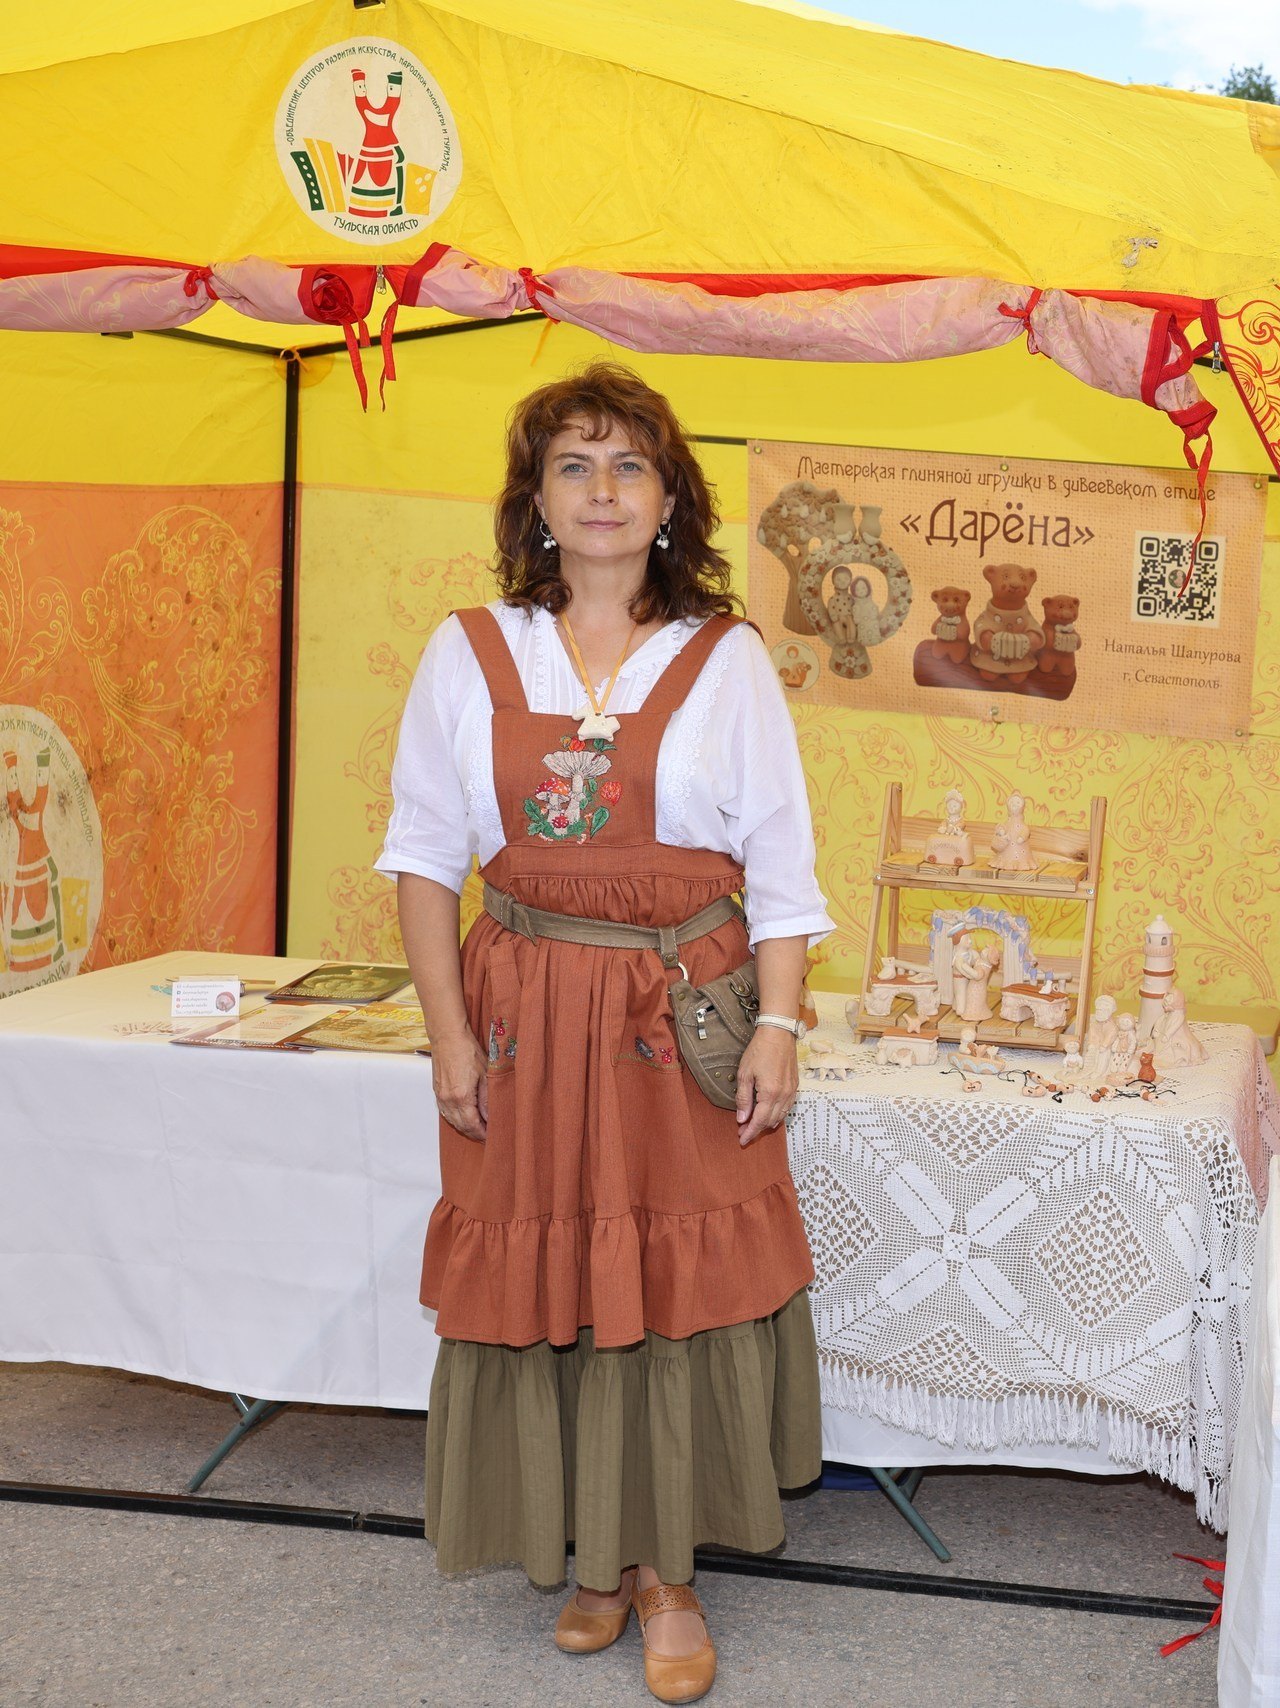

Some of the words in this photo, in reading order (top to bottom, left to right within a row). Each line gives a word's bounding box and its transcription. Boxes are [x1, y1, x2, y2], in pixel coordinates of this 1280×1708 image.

[298, 61, 325, 89] ЦЕНТРОВ
[325, 47, 356, 66] РАЗВИТИЯ
[426, 88, 446, 126] КУЛЬТУРЫ
[333, 216, 380, 236] ТУЛЬСКАЯ
[382, 219, 419, 235] ОБЛАСТЬ
[797, 456, 896, 483] Мастерская
[901, 468, 972, 485] глиняной
[977, 473, 1042, 493] игрушки
[899, 498, 1096, 559] «Дарёна»
[1104, 638, 1166, 657] Наталья
[1171, 644, 1241, 665] Шапурова
[1122, 671, 1131, 682] г.
[1135, 668, 1221, 690] Севастополь
